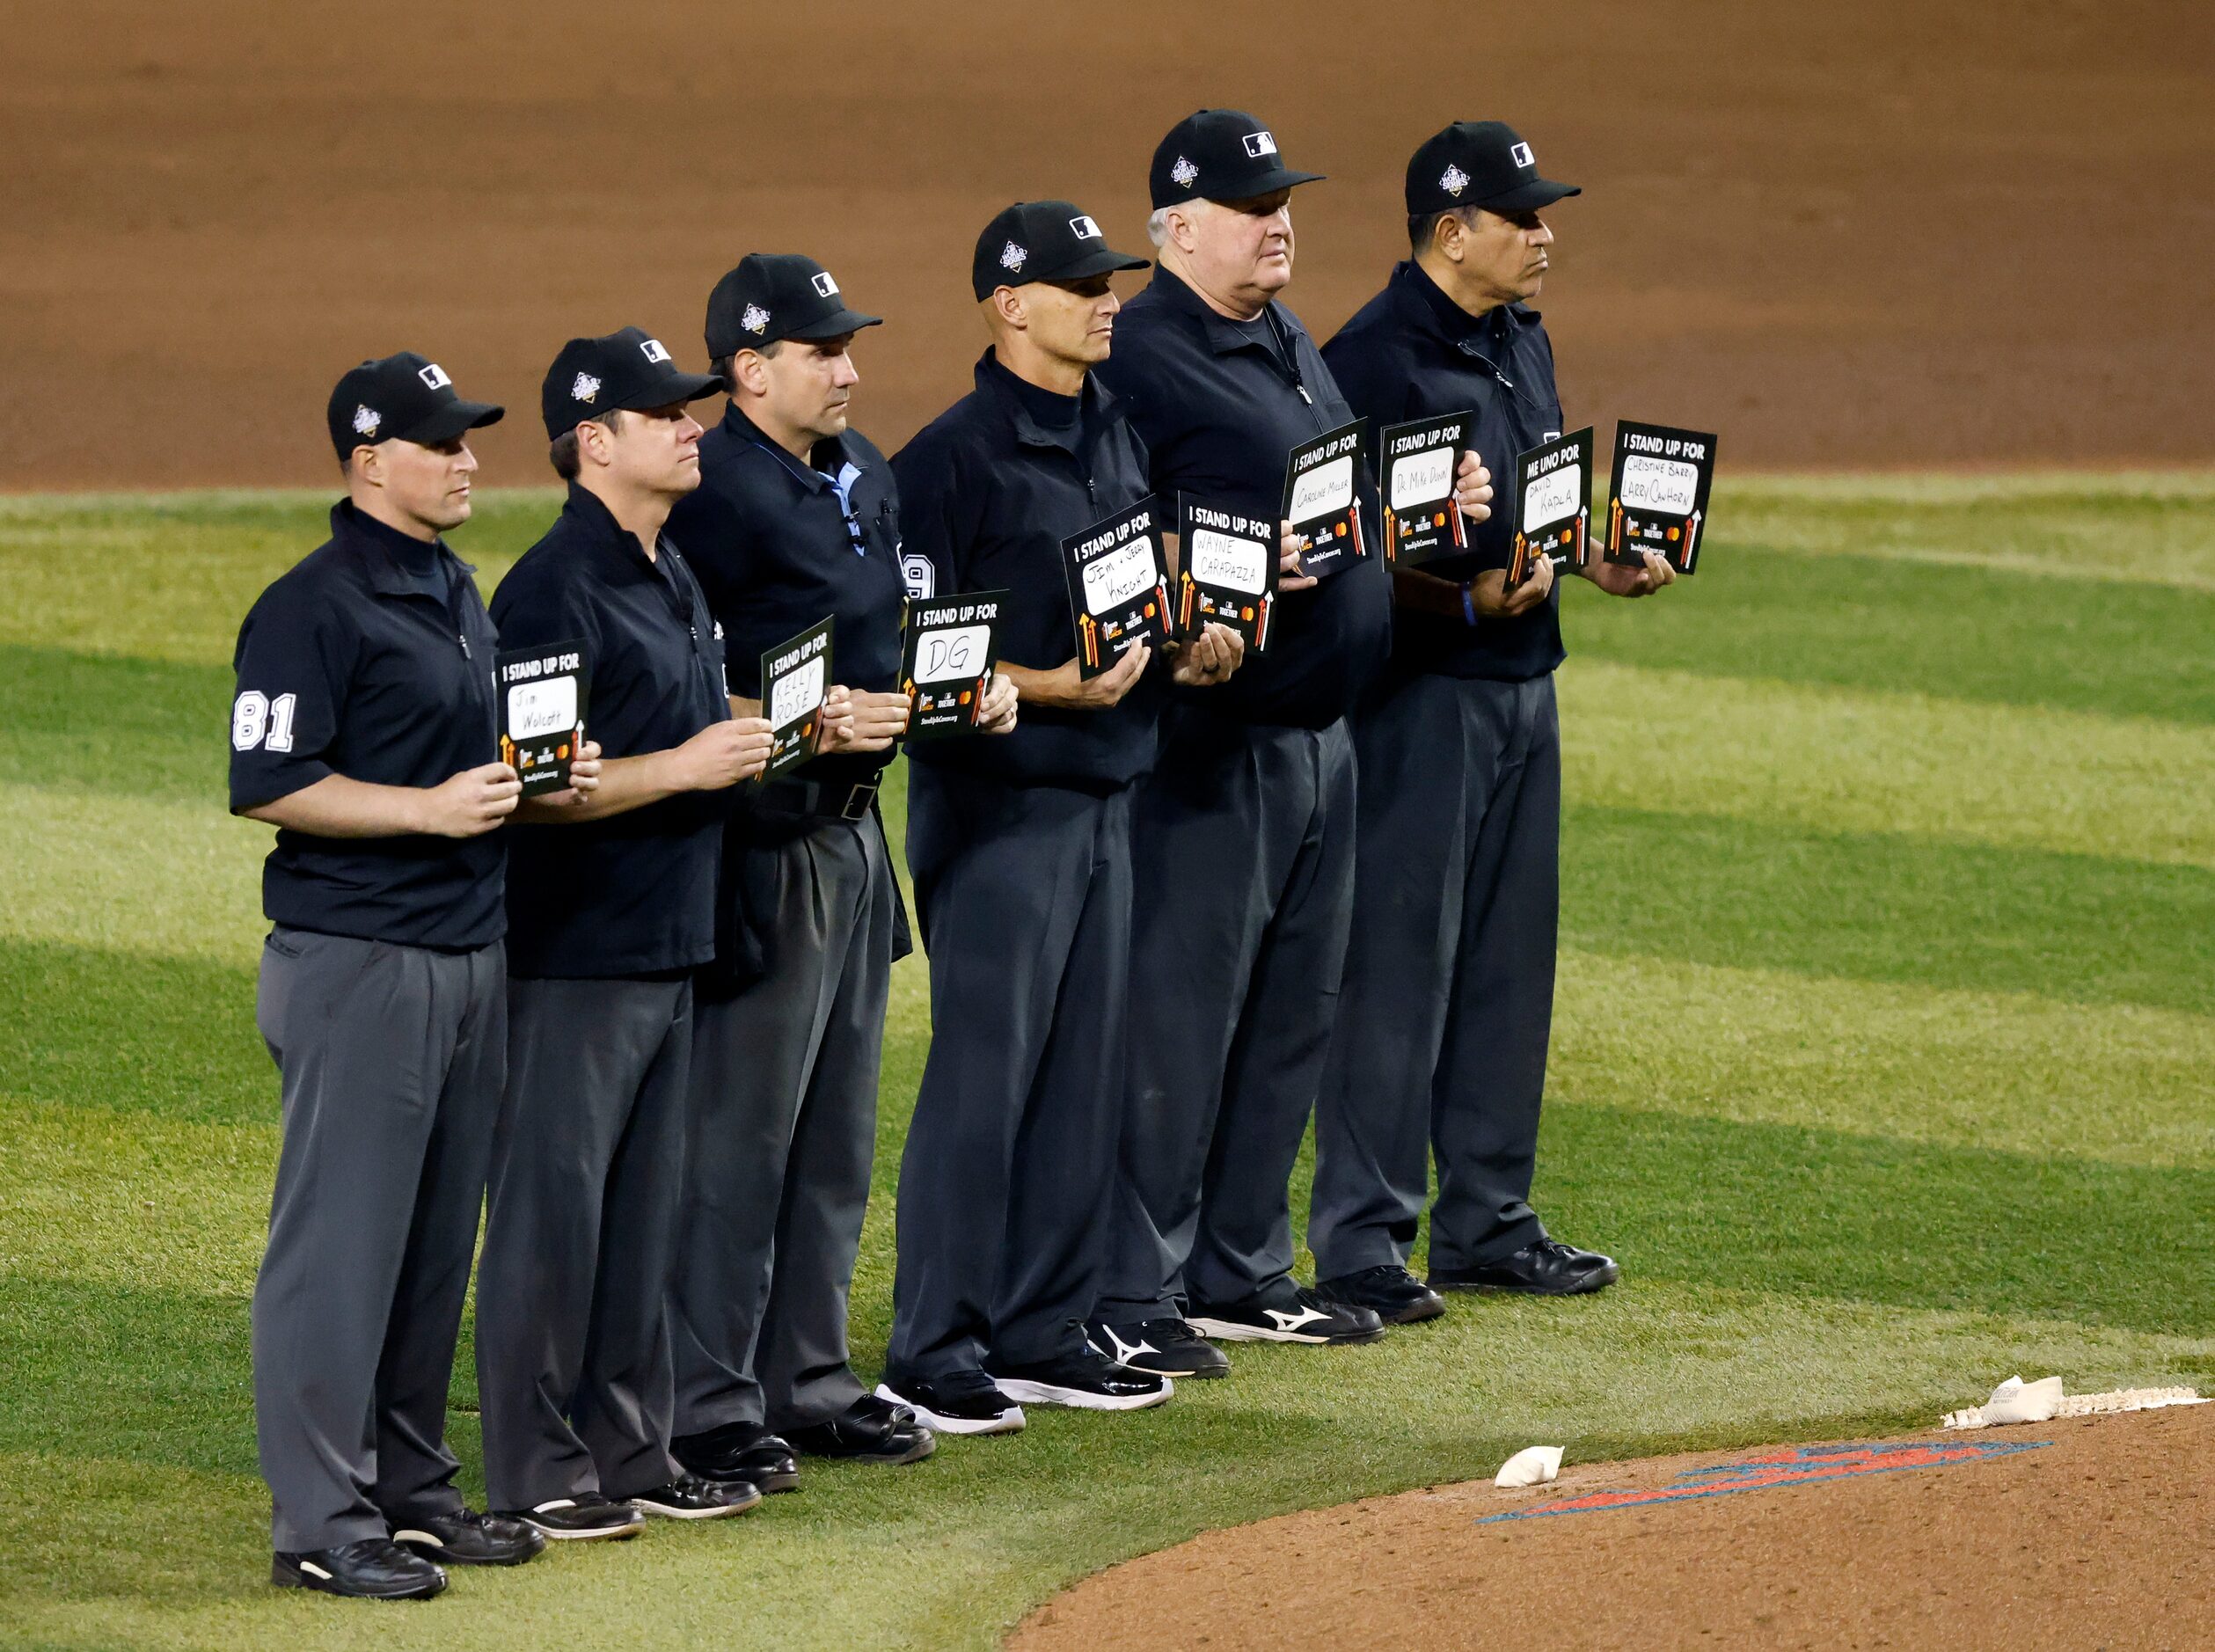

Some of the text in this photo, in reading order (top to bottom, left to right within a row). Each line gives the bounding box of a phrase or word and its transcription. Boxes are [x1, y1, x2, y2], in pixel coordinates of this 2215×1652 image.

[1294, 433, 1357, 473] I STAND UP FOR
[1391, 425, 1461, 455] I STAND UP FOR
[1624, 433, 1705, 461] I STAND UP FOR
[1527, 443, 1580, 479] ME UNO POR
[1530, 477, 1551, 498] DAVID
[1074, 512, 1151, 563] I STAND UP FOR
[1189, 506, 1271, 539] I STAND UP FOR
[1195, 533, 1235, 554] WAYNE
[1106, 569, 1147, 603] KNIGHT
[1201, 556, 1256, 583] CARAPAZZA
[917, 603, 998, 626] I STAND UP FOR
[502, 653, 580, 682] I STAND UP FOR
[770, 632, 828, 679] I STAND UP FOR
[926, 635, 970, 676] DG
[515, 689, 537, 707] Jim
[776, 666, 815, 702] KELLY
[232, 690, 296, 753] 81
[775, 691, 809, 728] ROSE
